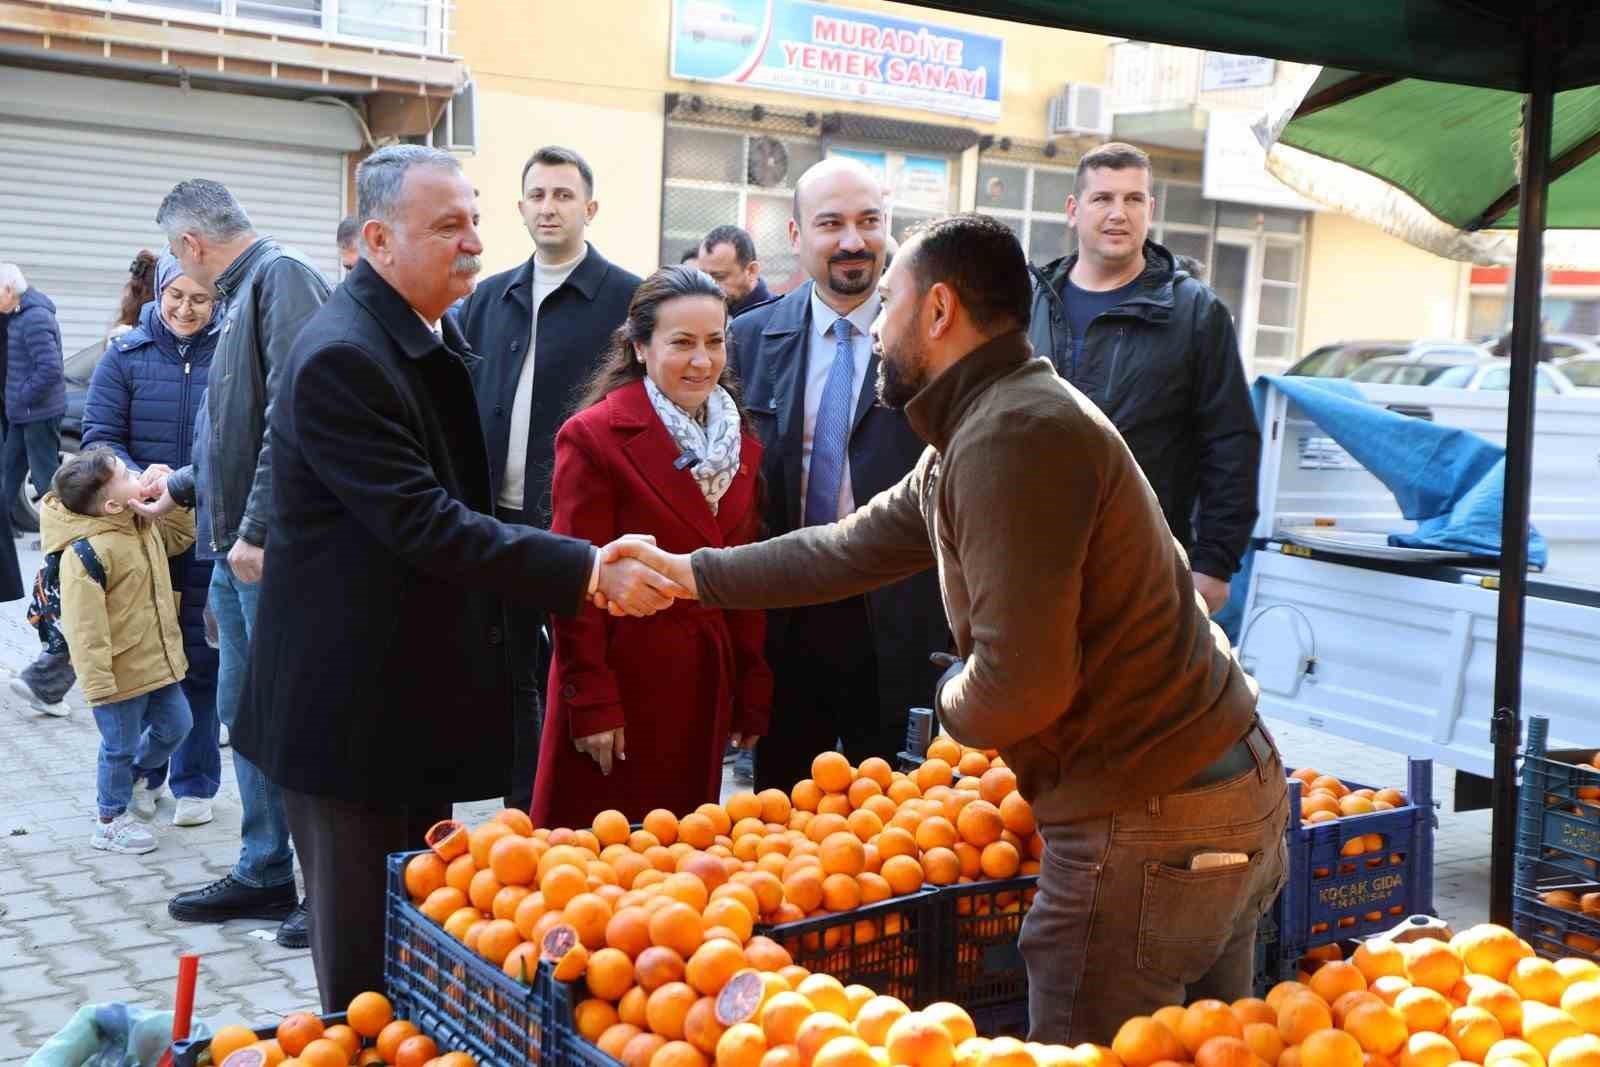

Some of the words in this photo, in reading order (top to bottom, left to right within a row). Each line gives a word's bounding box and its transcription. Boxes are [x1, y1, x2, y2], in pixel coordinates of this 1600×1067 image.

[814, 17, 962, 62] MURADİYE
[783, 44, 879, 78] YEMEK
[889, 61, 985, 96] SANAYİ
